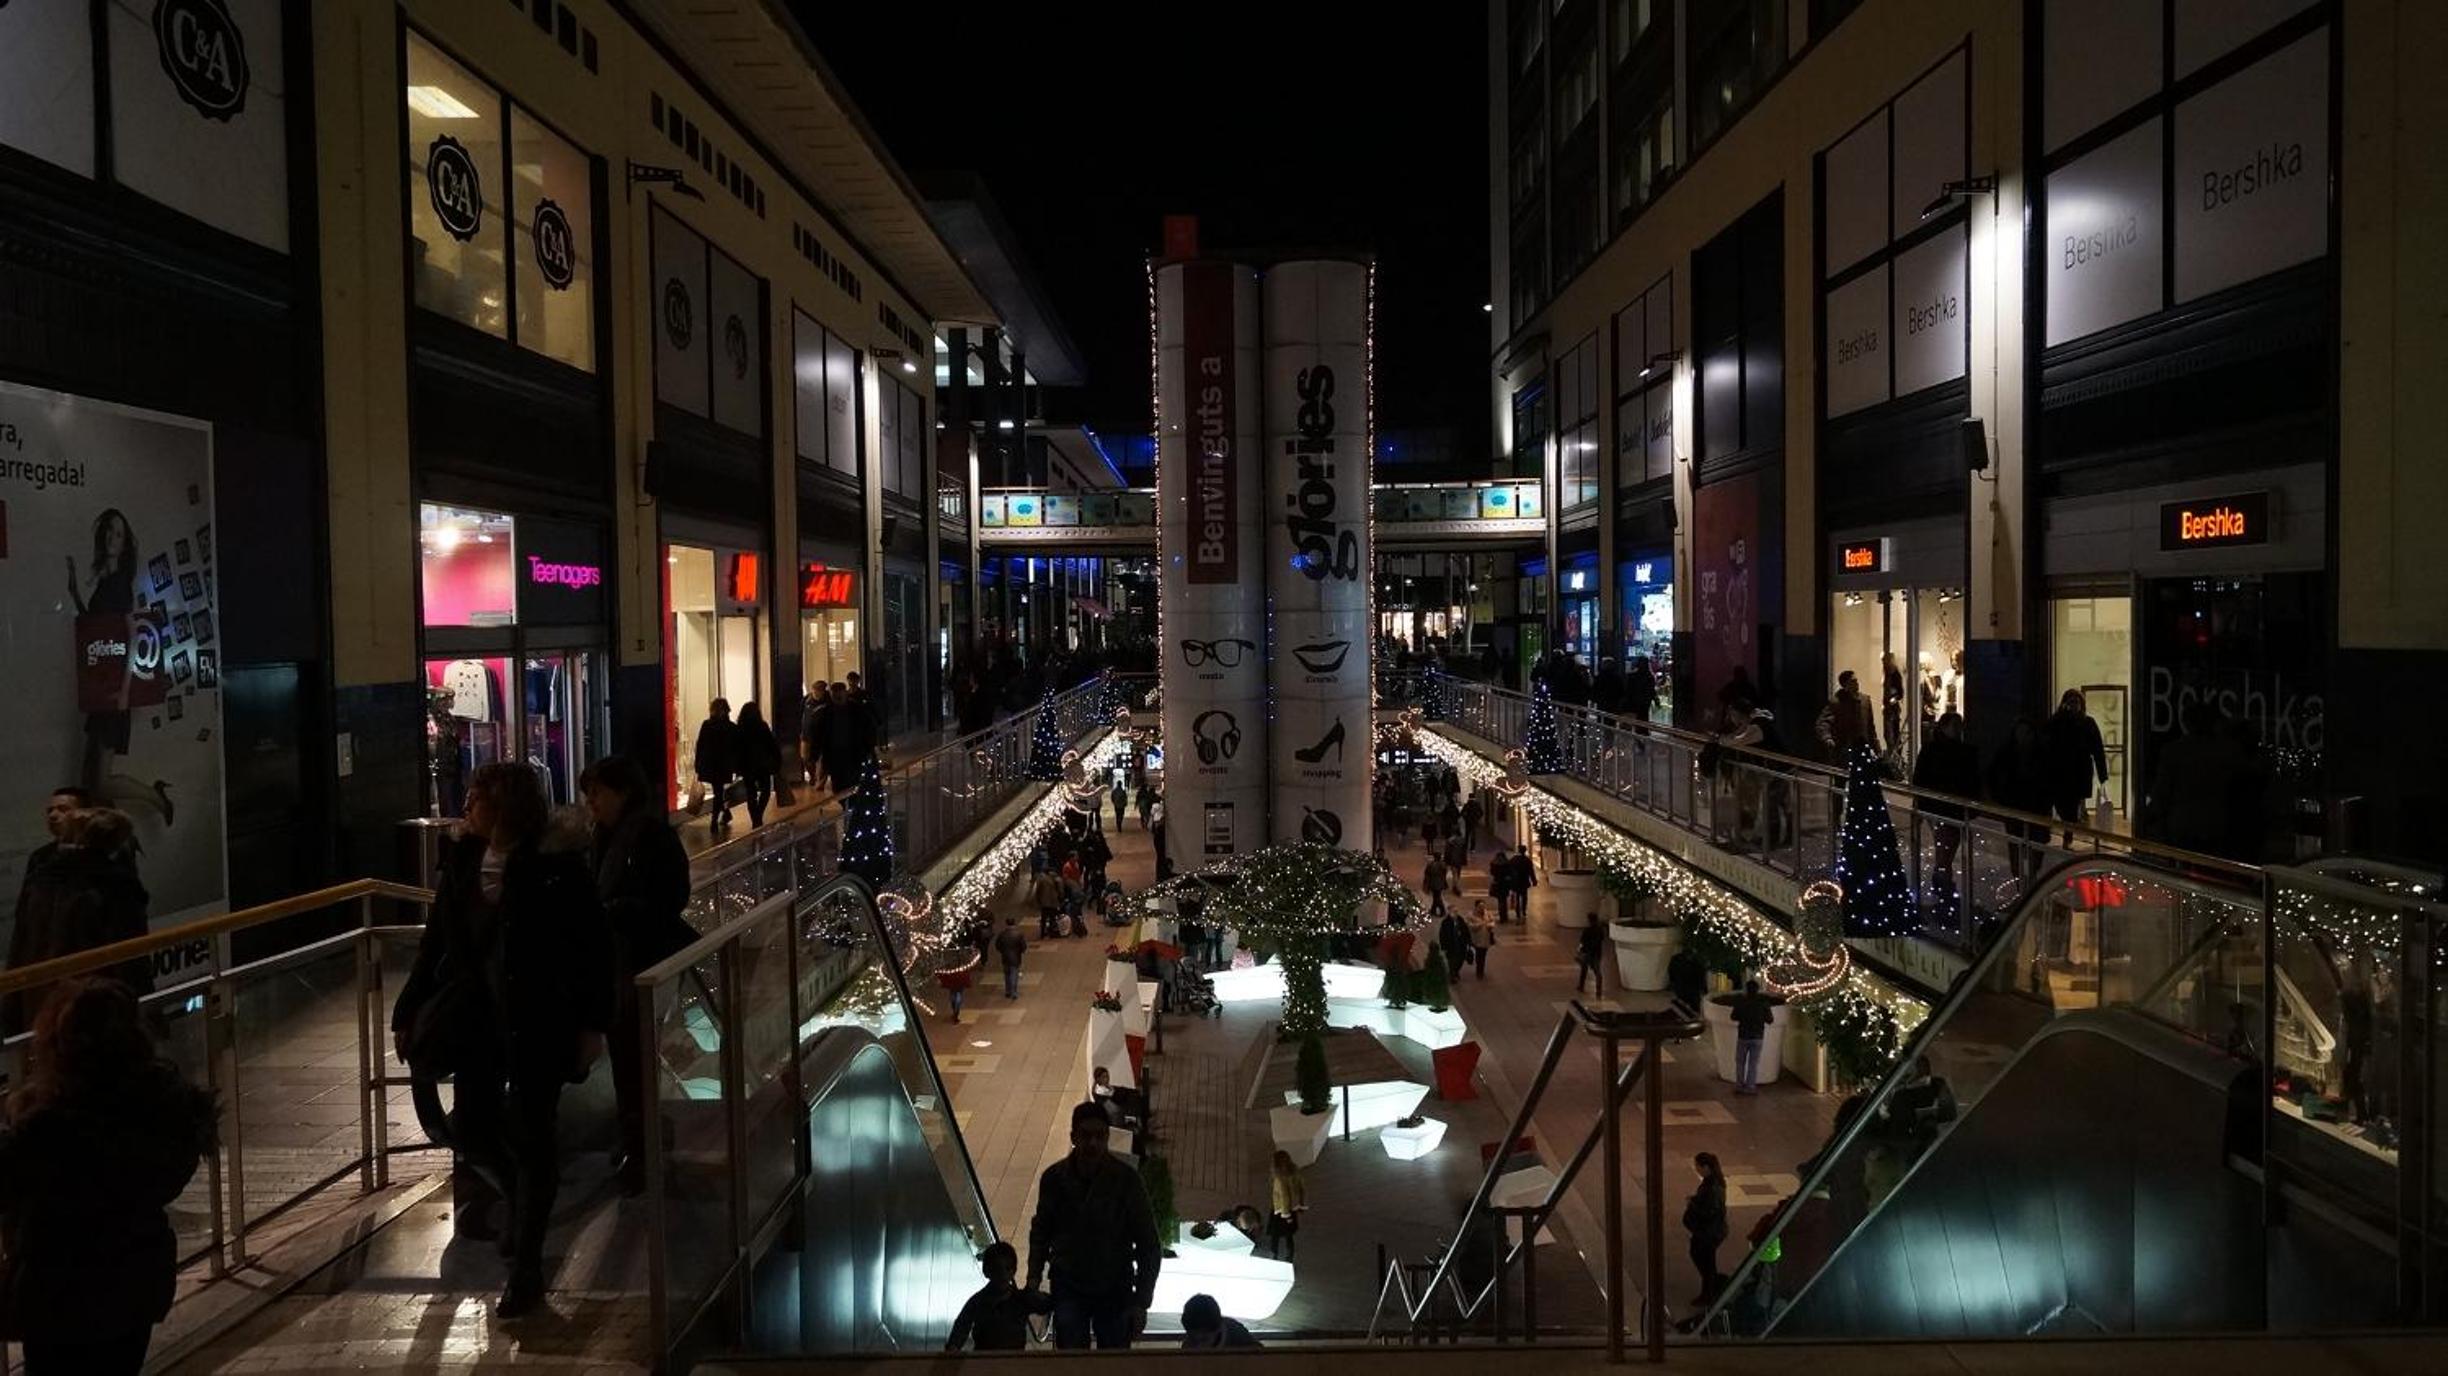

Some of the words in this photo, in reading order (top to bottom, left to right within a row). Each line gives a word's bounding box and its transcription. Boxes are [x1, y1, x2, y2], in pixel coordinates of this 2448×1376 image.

[172, 8, 235, 93] C&A
[437, 160, 475, 220] C&A
[2203, 142, 2302, 212] Bershka
[540, 220, 569, 271] C&A
[2064, 208, 2138, 271] Bershka
[1908, 294, 1957, 336] Bershka
[1201, 354, 1223, 375] a
[1838, 328, 1879, 365] Bershka
[0, 458, 84, 490] arregada!
[1196, 386, 1230, 565] Benvinguts
[2182, 506, 2244, 540] Bershka
[528, 556, 600, 589] Teenagers
[804, 573, 852, 604] H&M
